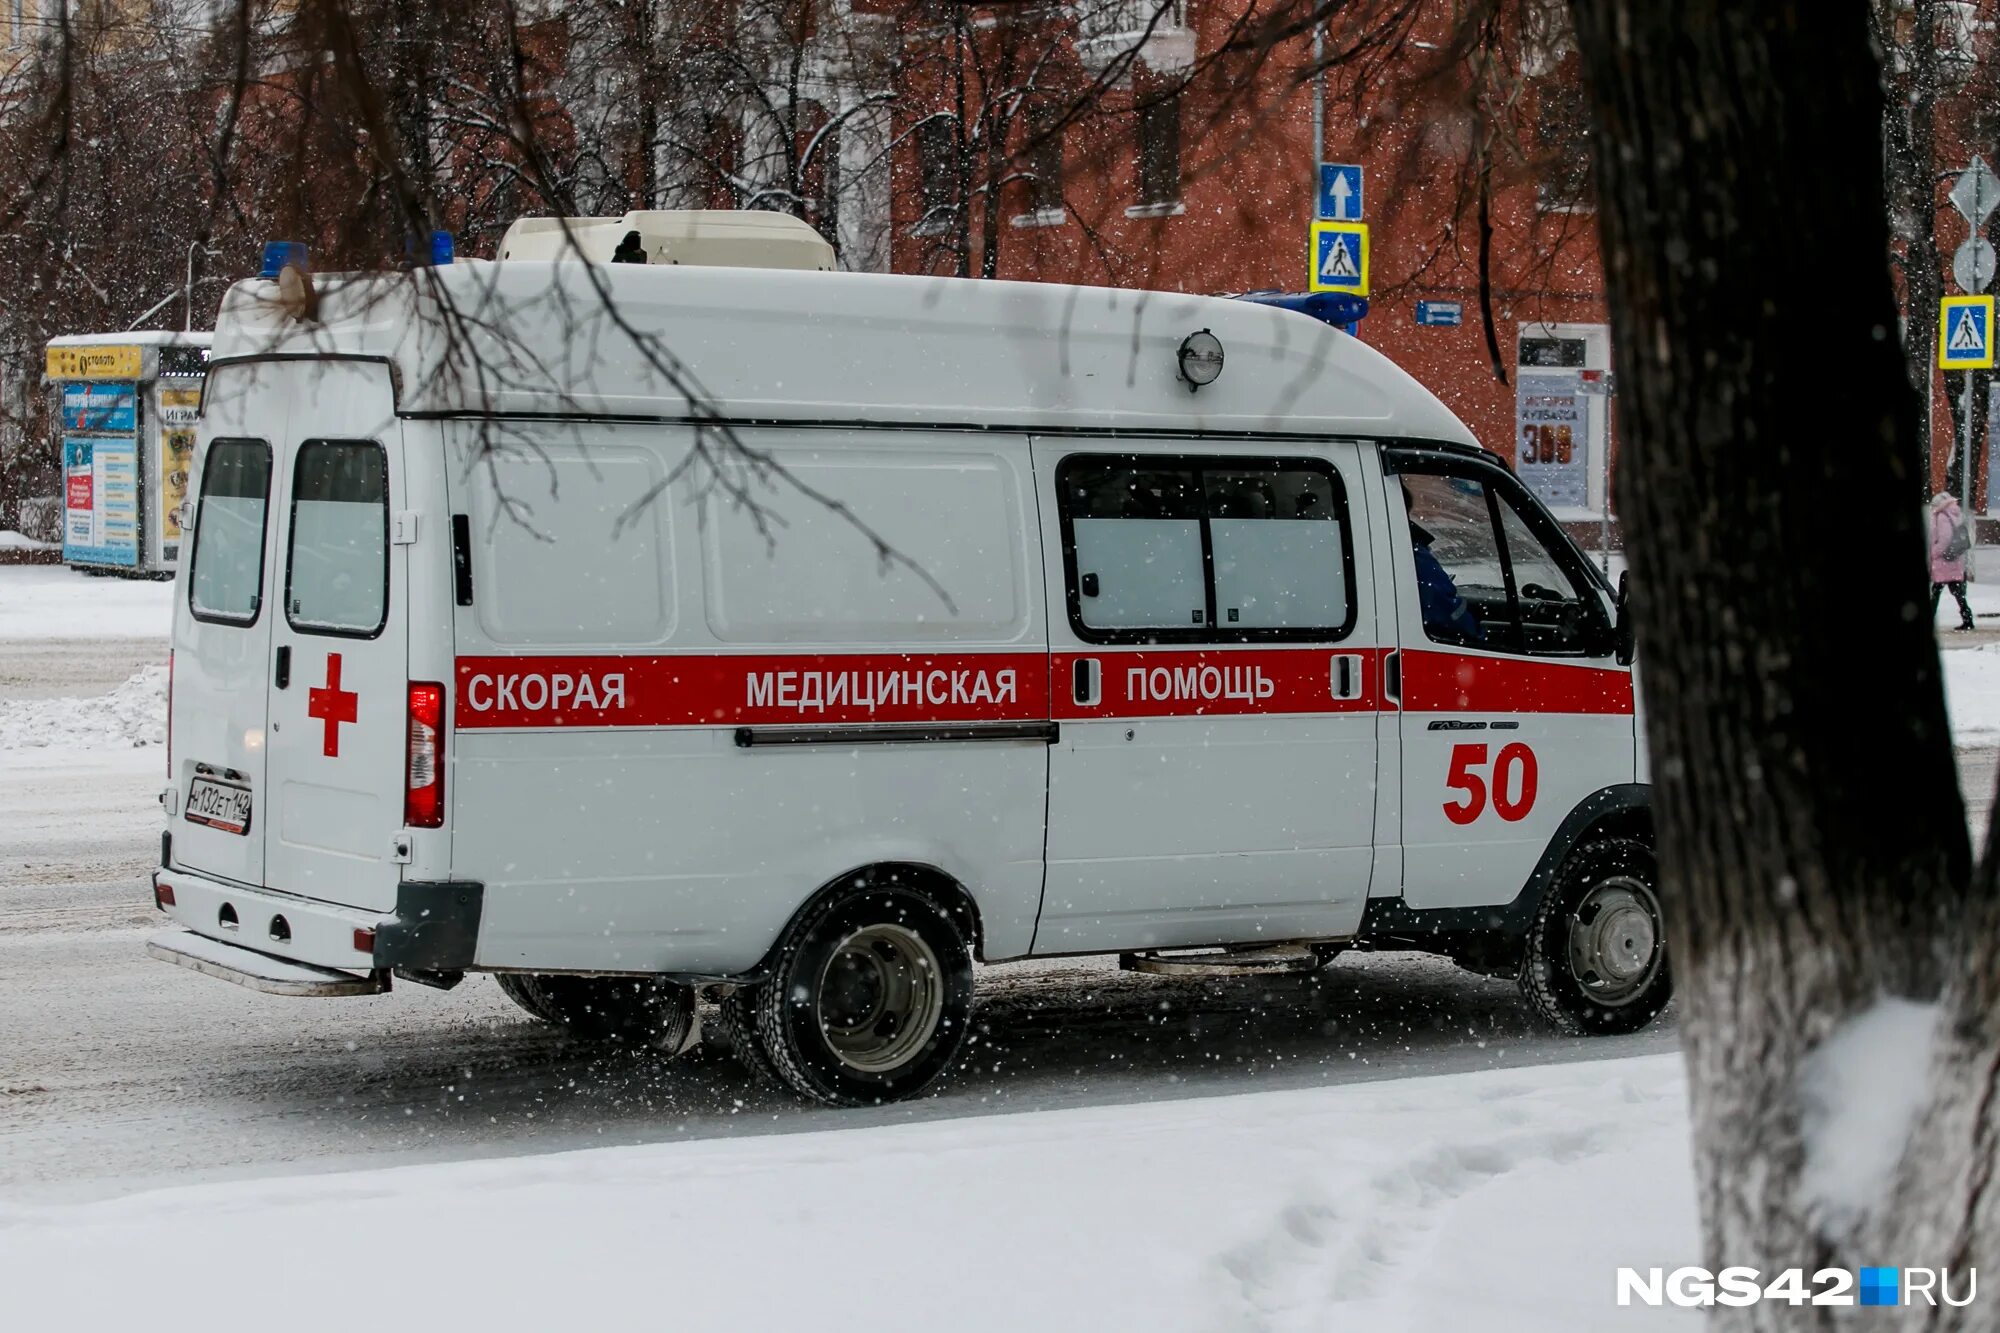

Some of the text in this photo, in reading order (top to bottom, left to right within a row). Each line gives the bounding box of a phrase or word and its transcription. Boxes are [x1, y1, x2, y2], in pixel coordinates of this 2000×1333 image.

[468, 666, 1275, 713] СКОРАЯ МЕДИЦИНСКАЯ ПОМОЩЬ
[1442, 741, 1538, 825] 50
